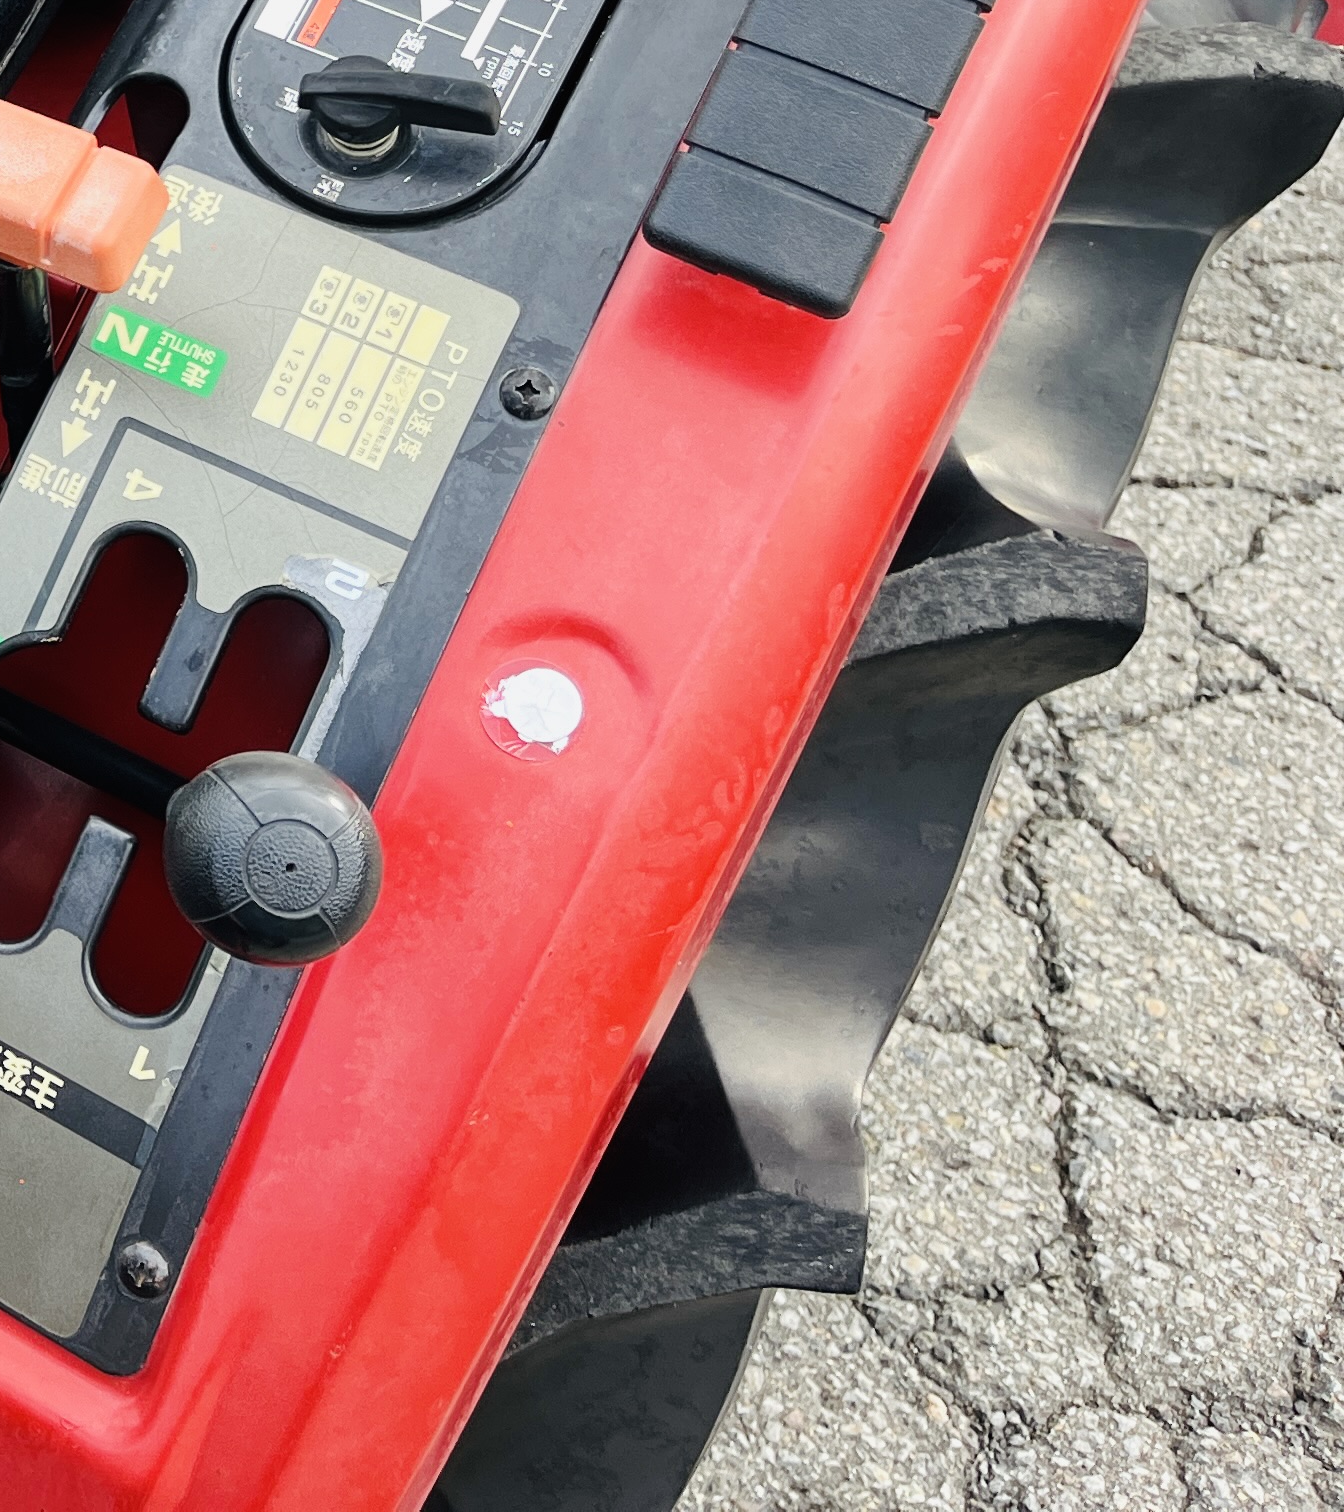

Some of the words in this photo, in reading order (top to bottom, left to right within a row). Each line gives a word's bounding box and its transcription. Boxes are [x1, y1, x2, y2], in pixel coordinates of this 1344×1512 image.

[387, 28, 427, 73] 速度
[481, 55, 501, 80] rpm
[537, 62, 555, 78] 10
[507, 119, 524, 136] 15
[164, 174, 224, 226] 後進
[308, 299, 328, 317] 3
[340, 311, 360, 330] 2
[95, 311, 150, 357] N
[158, 330, 217, 365] SHUTTLE
[375, 327, 393, 340] 1
[273, 348, 306, 397] 1230
[305, 373, 331, 410] 805
[338, 386, 365, 424] 560
[373, 392, 394, 422] PTO
[355, 432, 373, 457] rpm
[18, 453, 88, 509] 前進
[122, 467, 164, 501] 4
[324, 558, 370, 601] 2
[128, 1045, 157, 1081] 1
